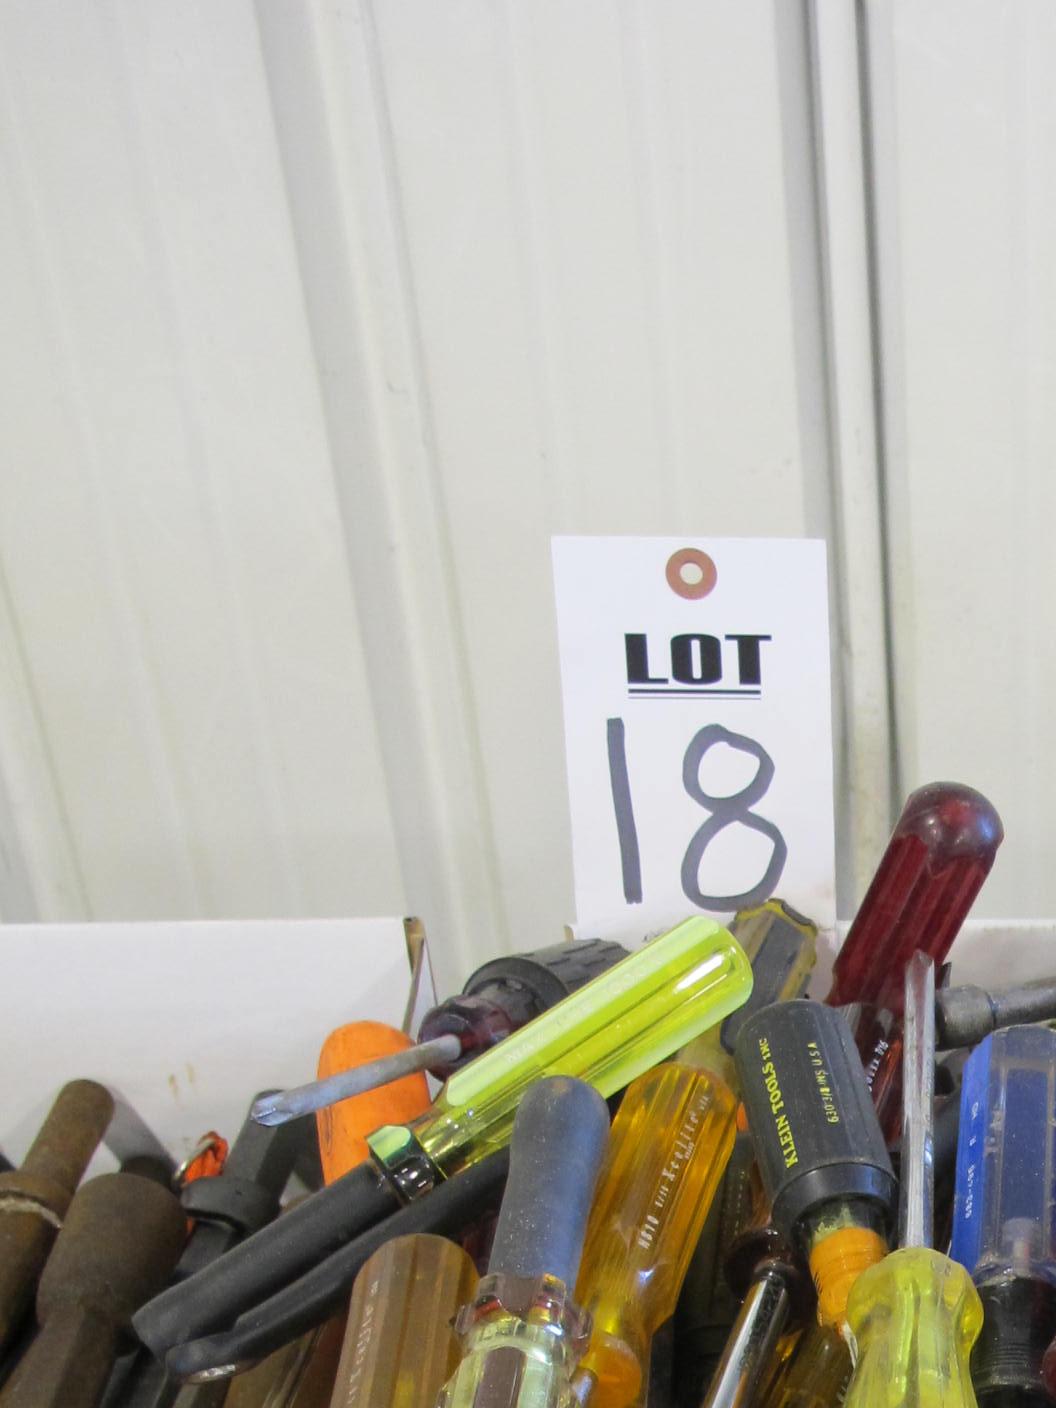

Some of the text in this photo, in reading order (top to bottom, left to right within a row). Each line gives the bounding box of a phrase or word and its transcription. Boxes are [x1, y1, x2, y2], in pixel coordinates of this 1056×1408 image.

[624, 633, 772, 686] LOT
[606, 717, 788, 912] 18
[762, 1061, 785, 1114] TOOLS
[775, 1114, 799, 1169] KLEIN
